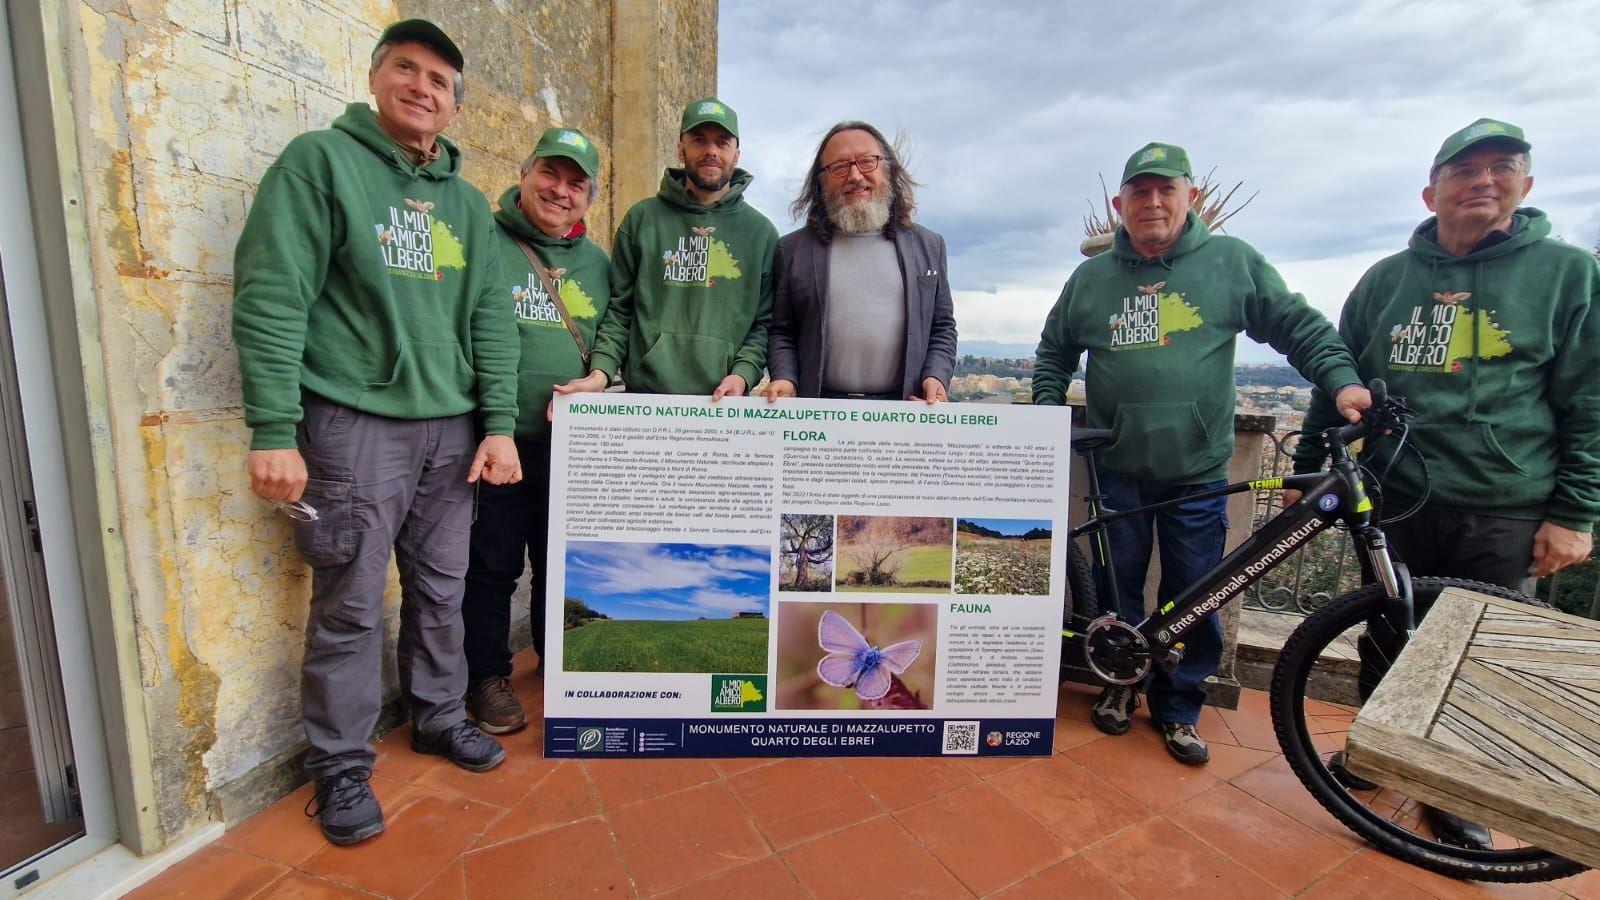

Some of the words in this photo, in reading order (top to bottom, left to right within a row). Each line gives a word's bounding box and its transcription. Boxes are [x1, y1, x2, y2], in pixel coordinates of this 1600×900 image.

[389, 206, 404, 228] IL
[403, 209, 431, 233] MIO
[387, 225, 433, 253] AMICO
[678, 236, 688, 252] IL
[689, 235, 709, 251] MIO
[672, 250, 708, 267] AMICO
[528, 272, 538, 291] IL
[663, 264, 707, 282] ALBERO
[523, 287, 556, 308] AMIC
[1123, 297, 1134, 313] IL
[1135, 293, 1158, 311] MIO
[514, 301, 562, 323] ALBERO
[1118, 309, 1158, 329] AMICO
[1410, 305, 1424, 325] IL
[1111, 325, 1159, 346] ALBERO
[1400, 324, 1452, 345] AMCO
[1389, 344, 1447, 365] ALBERO
[569, 404, 652, 416] MONUMENTO
[656, 406, 724, 418] NATURALE
[728, 408, 740, 418] DI
[744, 408, 847, 421] MAZZALUPETTO
[851, 411, 859, 421] E
[862, 411, 916, 423] QUARTO
[920, 413, 957, 425] DEGLI
[961, 415, 998, 425] EBREI
[783, 430, 827, 441] FLORA
[1248, 478, 1284, 491] XENON
[1169, 612, 1197, 635] Ente
[1192, 574, 1249, 617] Regionale
[1246, 517, 1323, 578] RomaNatura
[950, 603, 992, 614] FAUNA
[719, 687, 741, 697] AMICO
[722, 679, 728, 688] IL
[729, 679, 741, 688] MIO
[564, 690, 575, 698] IN
[576, 690, 658, 699] COLLABORAZIONE
[660, 691, 682, 699] CON:
[714, 695, 741, 705] ALBERO
[689, 724, 765, 734] MONUMENTO
[768, 724, 828, 734] NATURALE
[832, 724, 843, 734] DI
[847, 724, 936, 734] MAZZALUPETTO
[1005, 731, 1041, 739] REGIONE
[751, 736, 799, 746] QUARTO
[803, 736, 837, 746] DEGLI
[841, 736, 875, 746] EBREI
[1005, 738, 1030, 746] LAZIO
